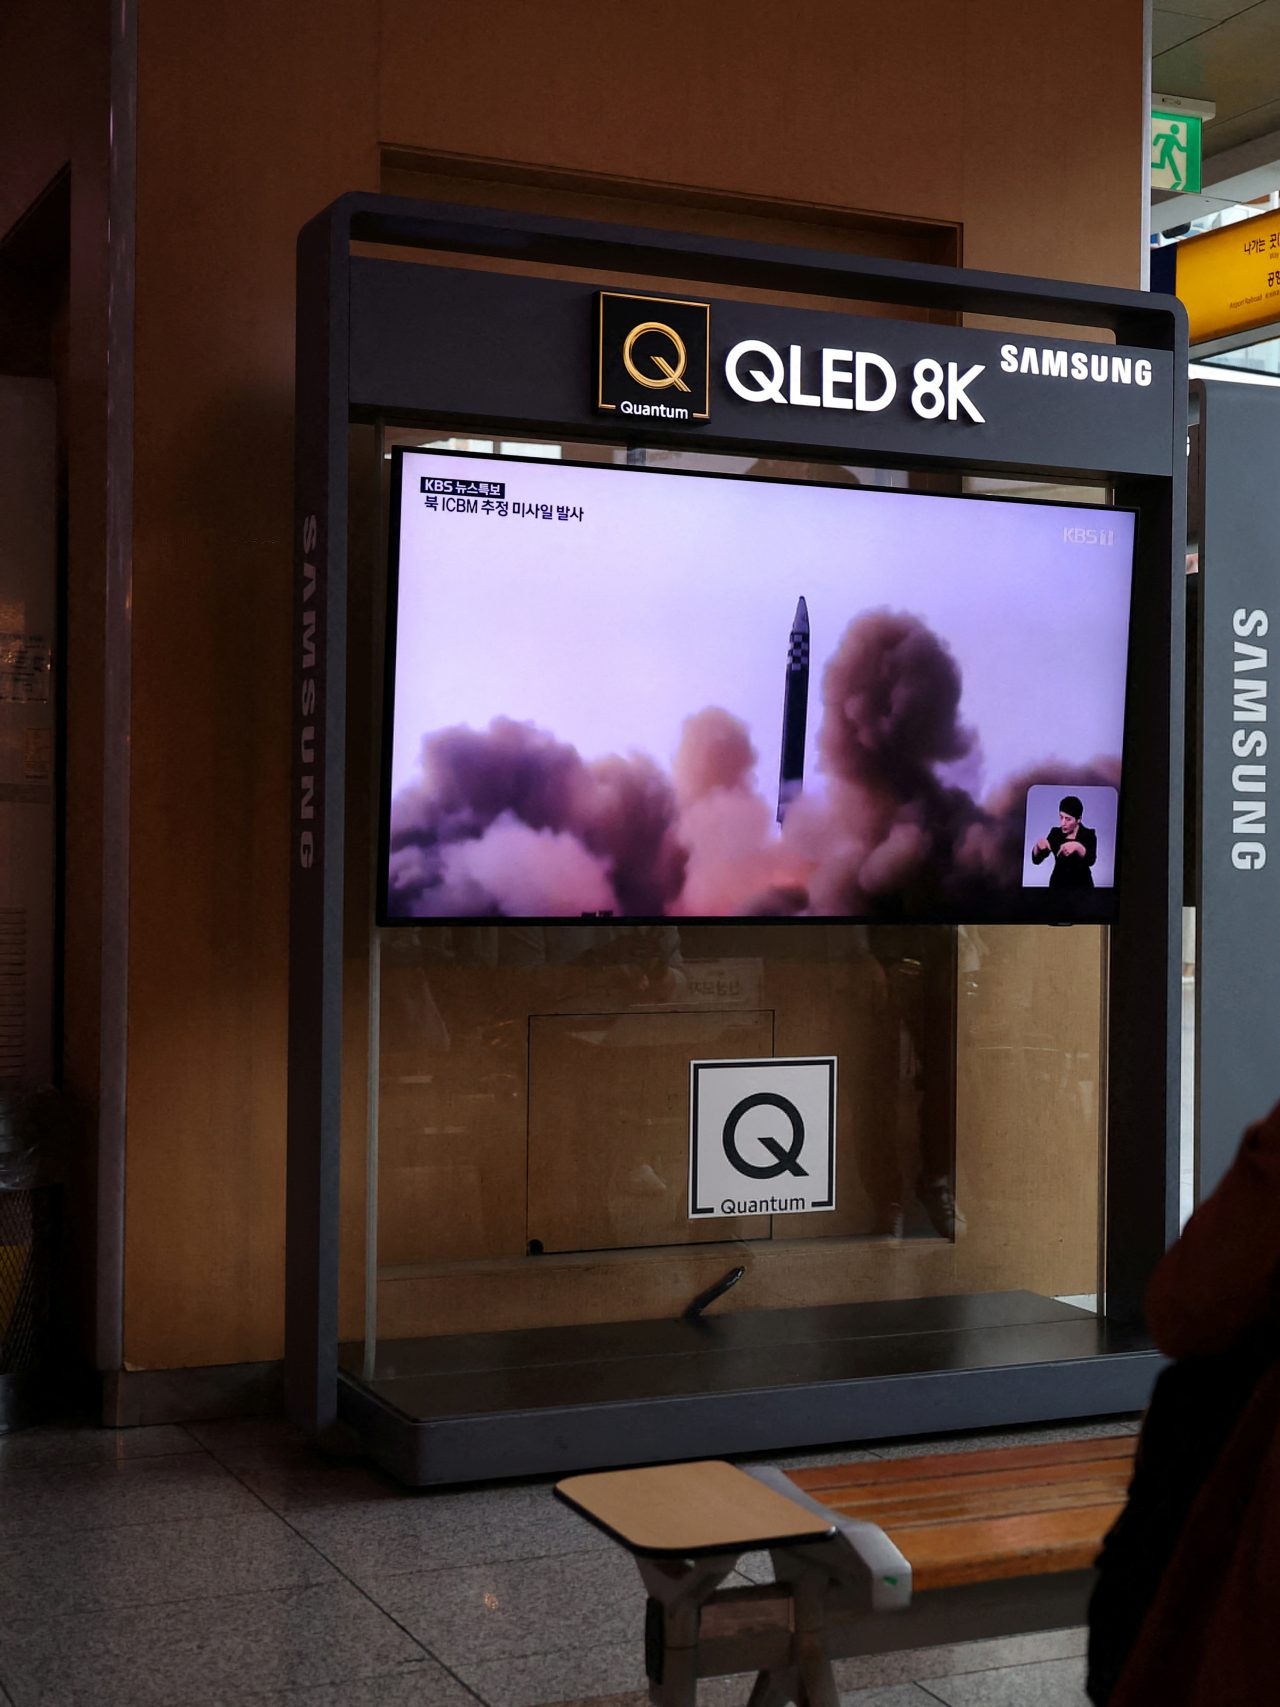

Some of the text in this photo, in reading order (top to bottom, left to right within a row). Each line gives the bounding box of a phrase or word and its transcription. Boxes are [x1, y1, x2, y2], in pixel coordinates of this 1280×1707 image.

[1244, 239, 1266, 255] 나가는
[623, 321, 692, 393] Q
[1000, 344, 1152, 387] SAMSUNG
[725, 339, 986, 423] QLED 8K
[620, 400, 689, 420] Quantum
[424, 478, 501, 496] KBS 뉴스특보
[424, 495, 585, 522] 북 ICBM 추정 미사일 발사
[301, 514, 317, 869] SAMSUNG
[1231, 607, 1269, 871] SAMSUNG
[722, 1092, 809, 1180] Q
[721, 1196, 805, 1214] Quantum
